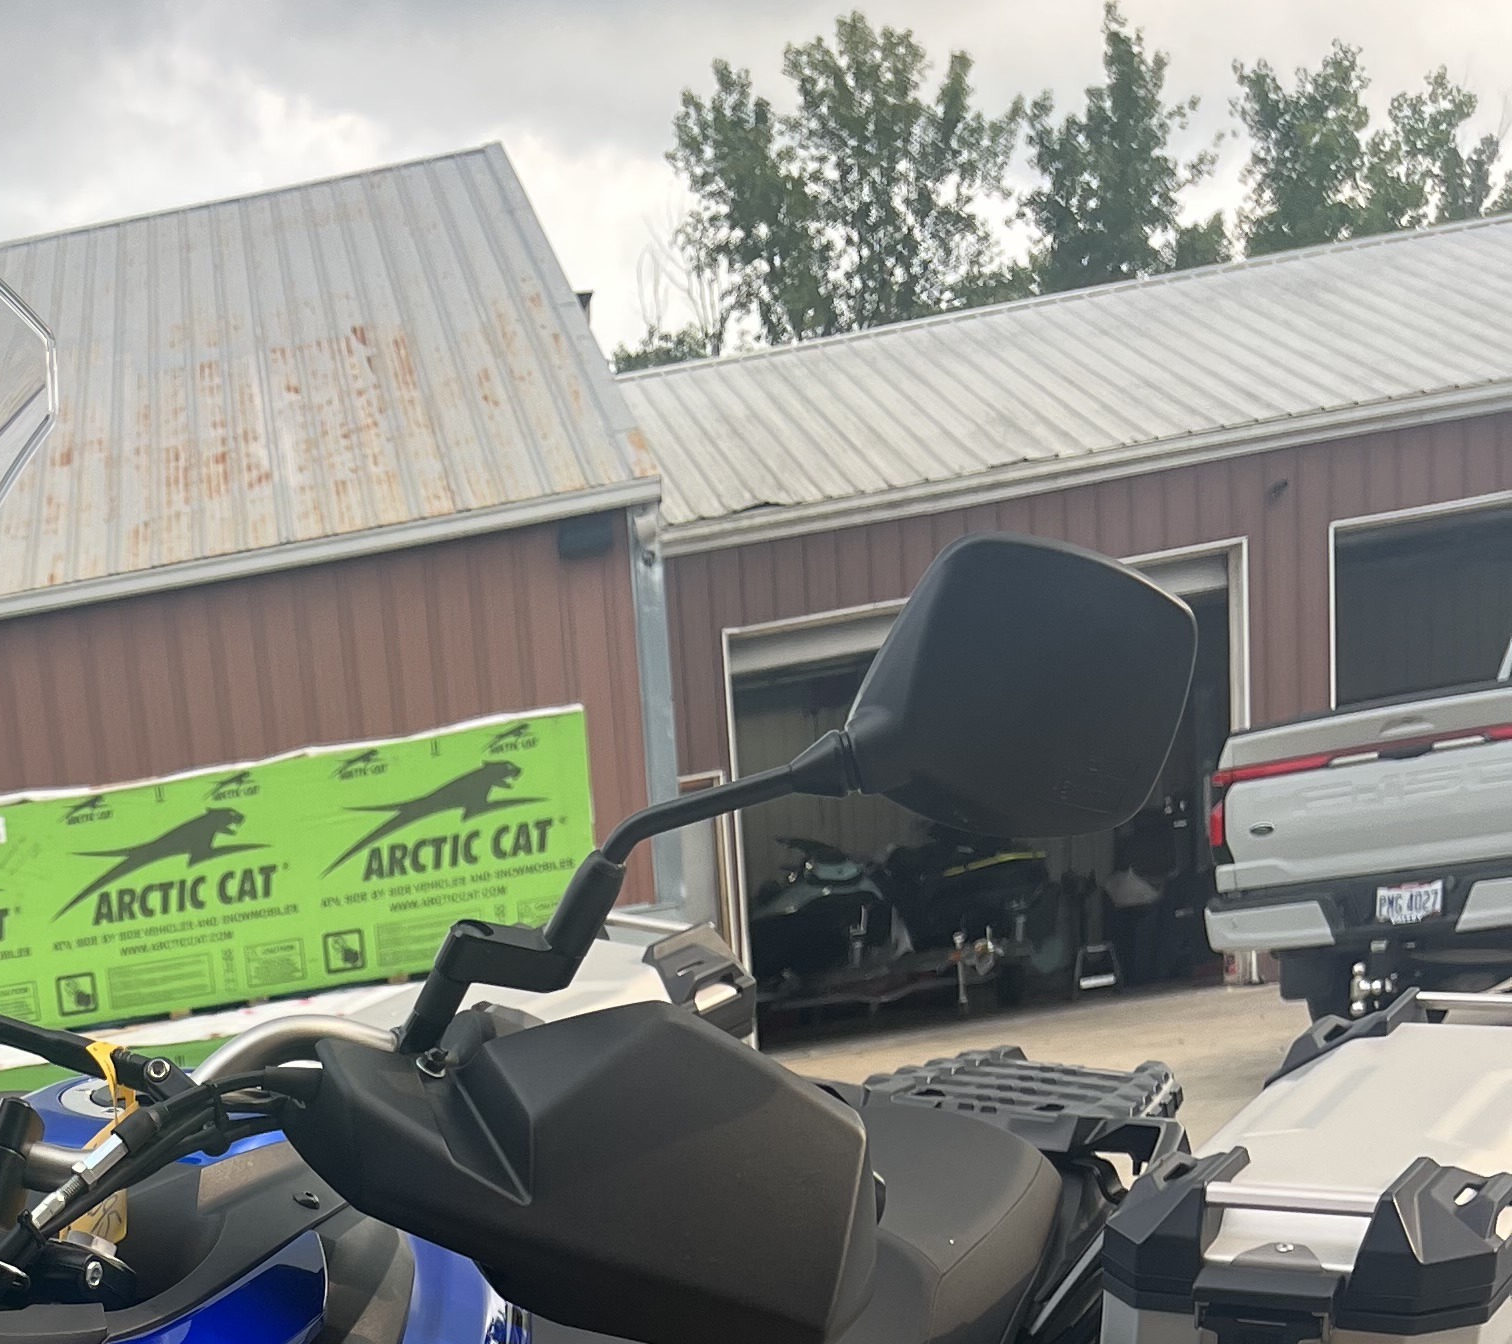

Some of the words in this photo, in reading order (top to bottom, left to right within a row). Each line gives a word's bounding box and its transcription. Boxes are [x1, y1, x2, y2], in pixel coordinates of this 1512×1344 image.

[362, 829, 482, 882] ARCTIC
[490, 818, 554, 860] CAT
[92, 874, 208, 926] ARCTIC
[217, 864, 278, 905] CAT
